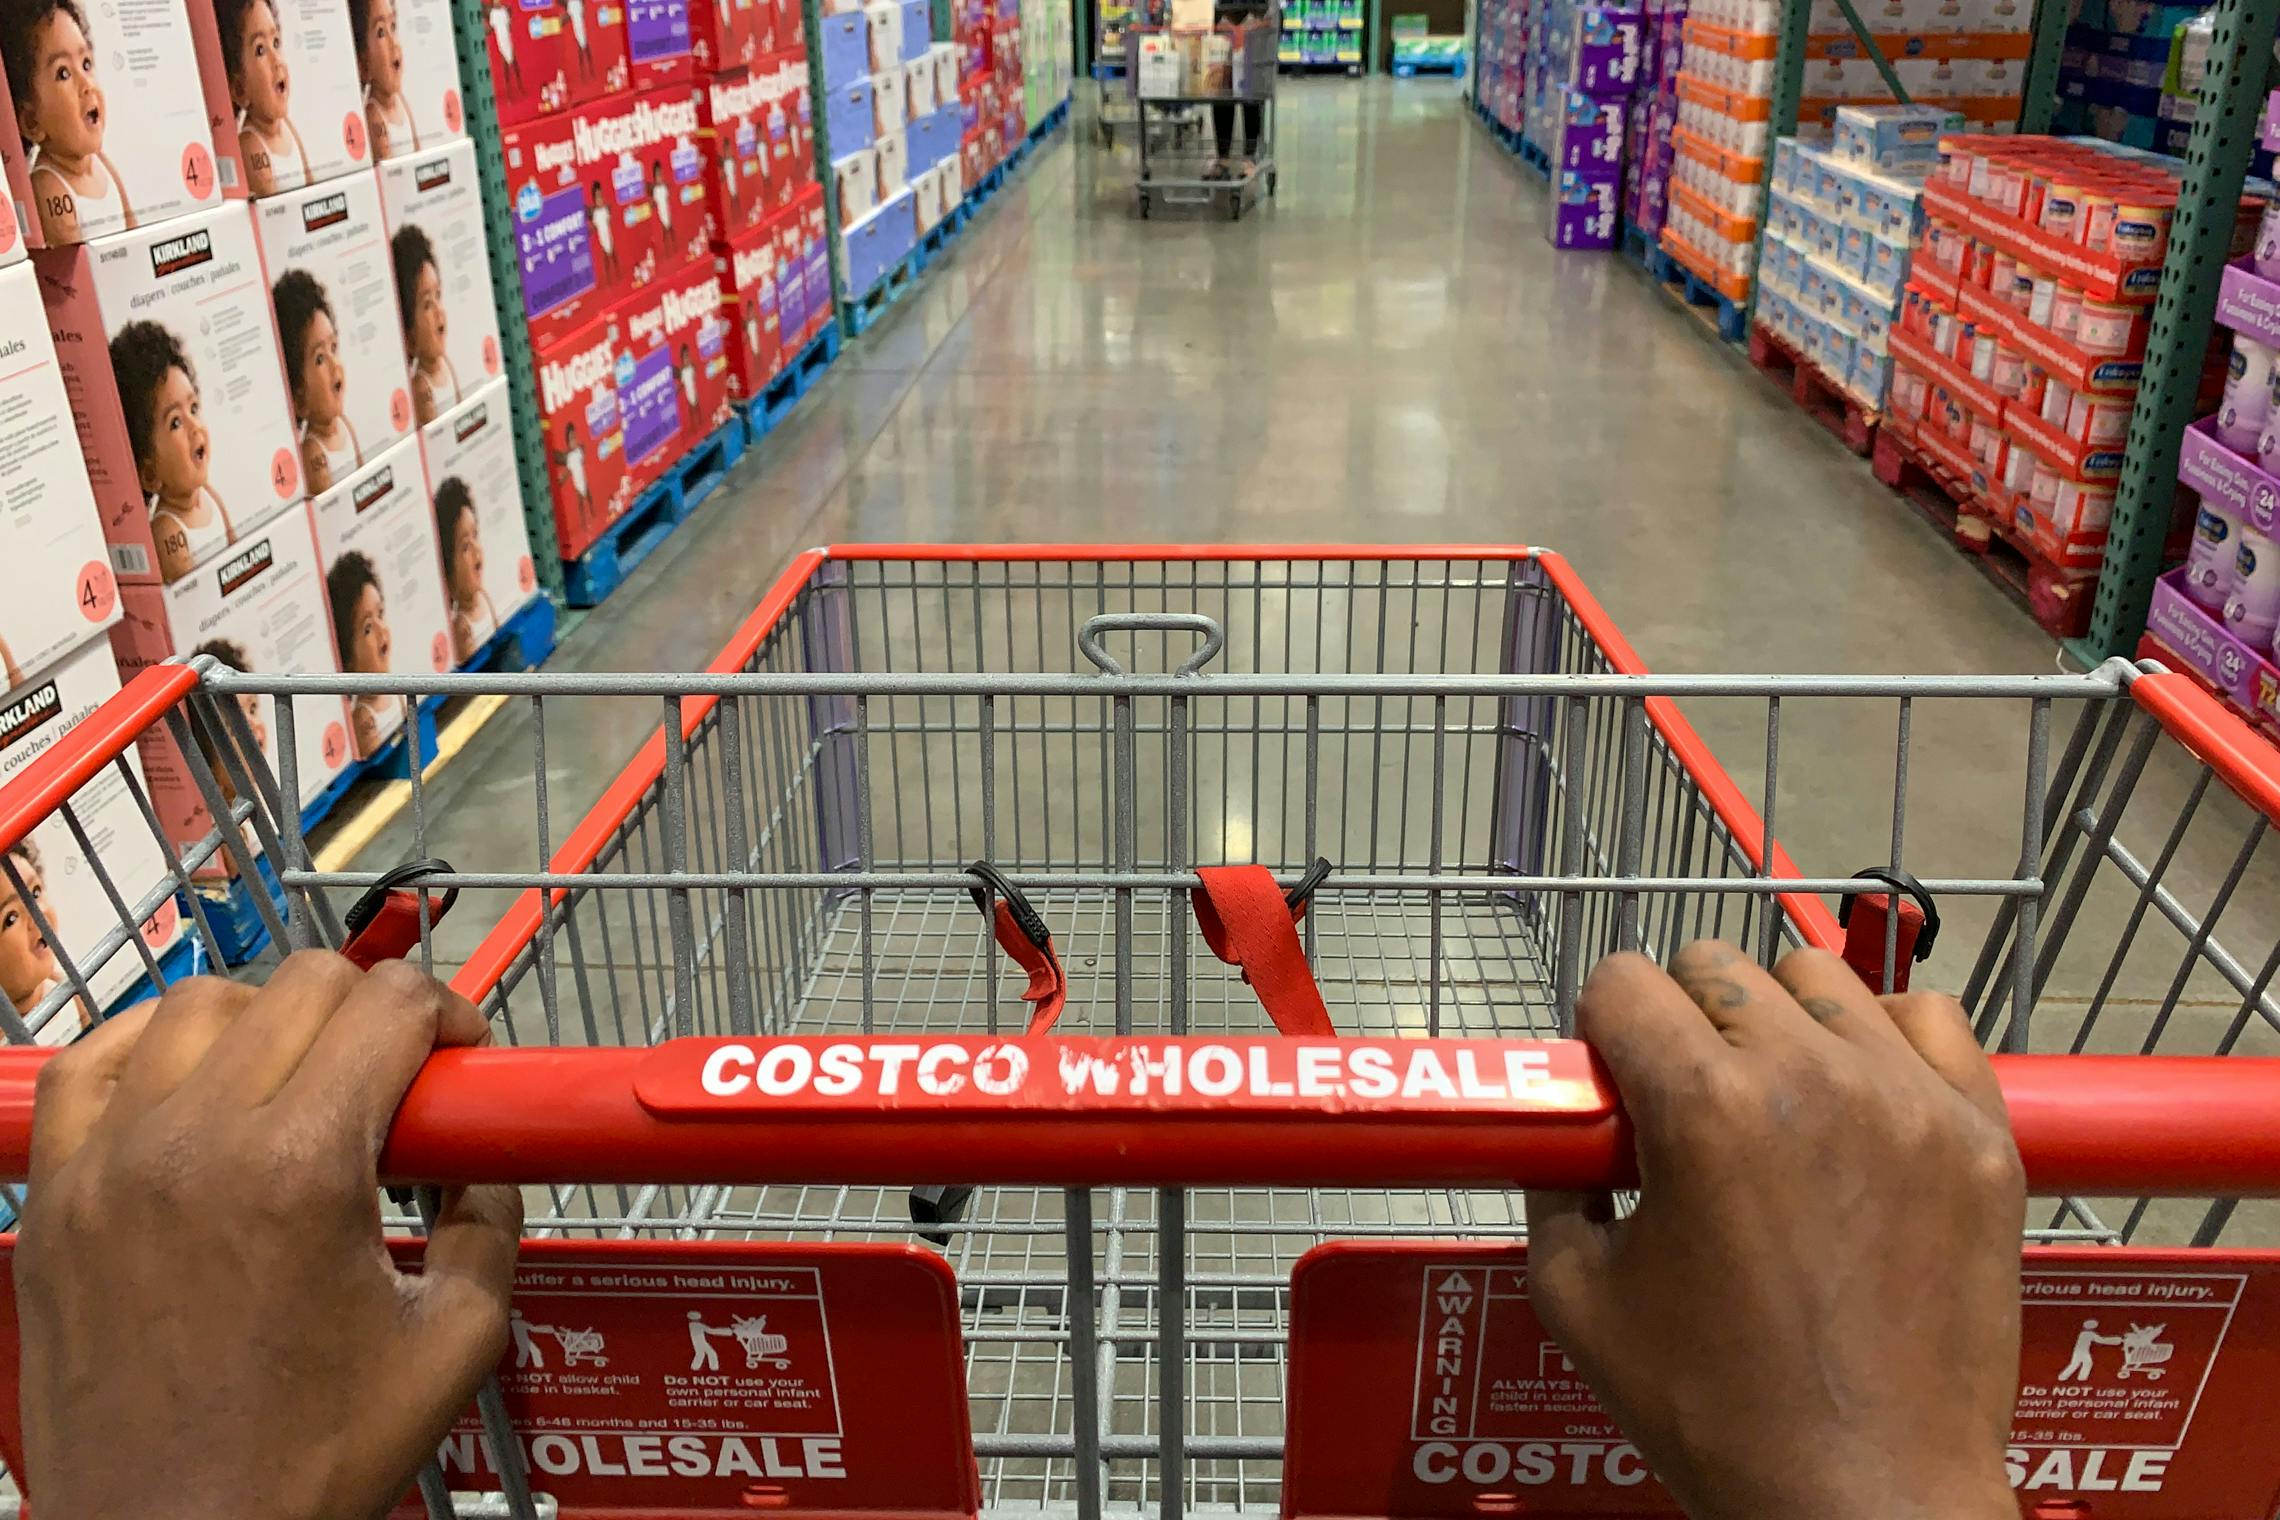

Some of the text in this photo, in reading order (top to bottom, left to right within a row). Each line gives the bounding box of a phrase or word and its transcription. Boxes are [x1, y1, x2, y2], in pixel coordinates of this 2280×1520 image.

[186, 156, 199, 187] 4
[46, 192, 73, 218] 180
[152, 232, 209, 265] KIRKLAND
[164, 530, 189, 556] 180
[82, 578, 98, 609] 4
[3, 733, 52, 773] couches
[701, 1043, 1556, 1099] COSTCO WHOLESALE
[513, 1272, 566, 1286] uffer
[590, 1274, 668, 1288] serious
[674, 1274, 724, 1289] head
[731, 1275, 796, 1292] injury.
[2088, 1283, 2141, 1296] head
[2148, 1284, 2214, 1299] injury.
[1430, 1295, 1473, 1435] WARNING
[604, 1375, 641, 1385] child
[664, 1375, 804, 1390] Do NOT use your
[1492, 1379, 1571, 1390] ALWAYS
[666, 1387, 821, 1399] own personal infant
[1533, 1391, 1547, 1401] in
[1552, 1391, 1583, 1402] cart
[2022, 1386, 2169, 1400] Do NOT use your
[723, 1399, 739, 1408] or
[744, 1399, 769, 1409] car
[2018, 1399, 2180, 1410] own personal infant
[2015, 1409, 2164, 1421] carrier or car seat.
[576, 1417, 634, 1428] months
[639, 1418, 668, 1429] and
[721, 1418, 749, 1430] lbs.
[1564, 1425, 1615, 1436] ONLY
[2058, 1432, 2086, 1442] lbs.
[1412, 1441, 1663, 1486] COSTC
